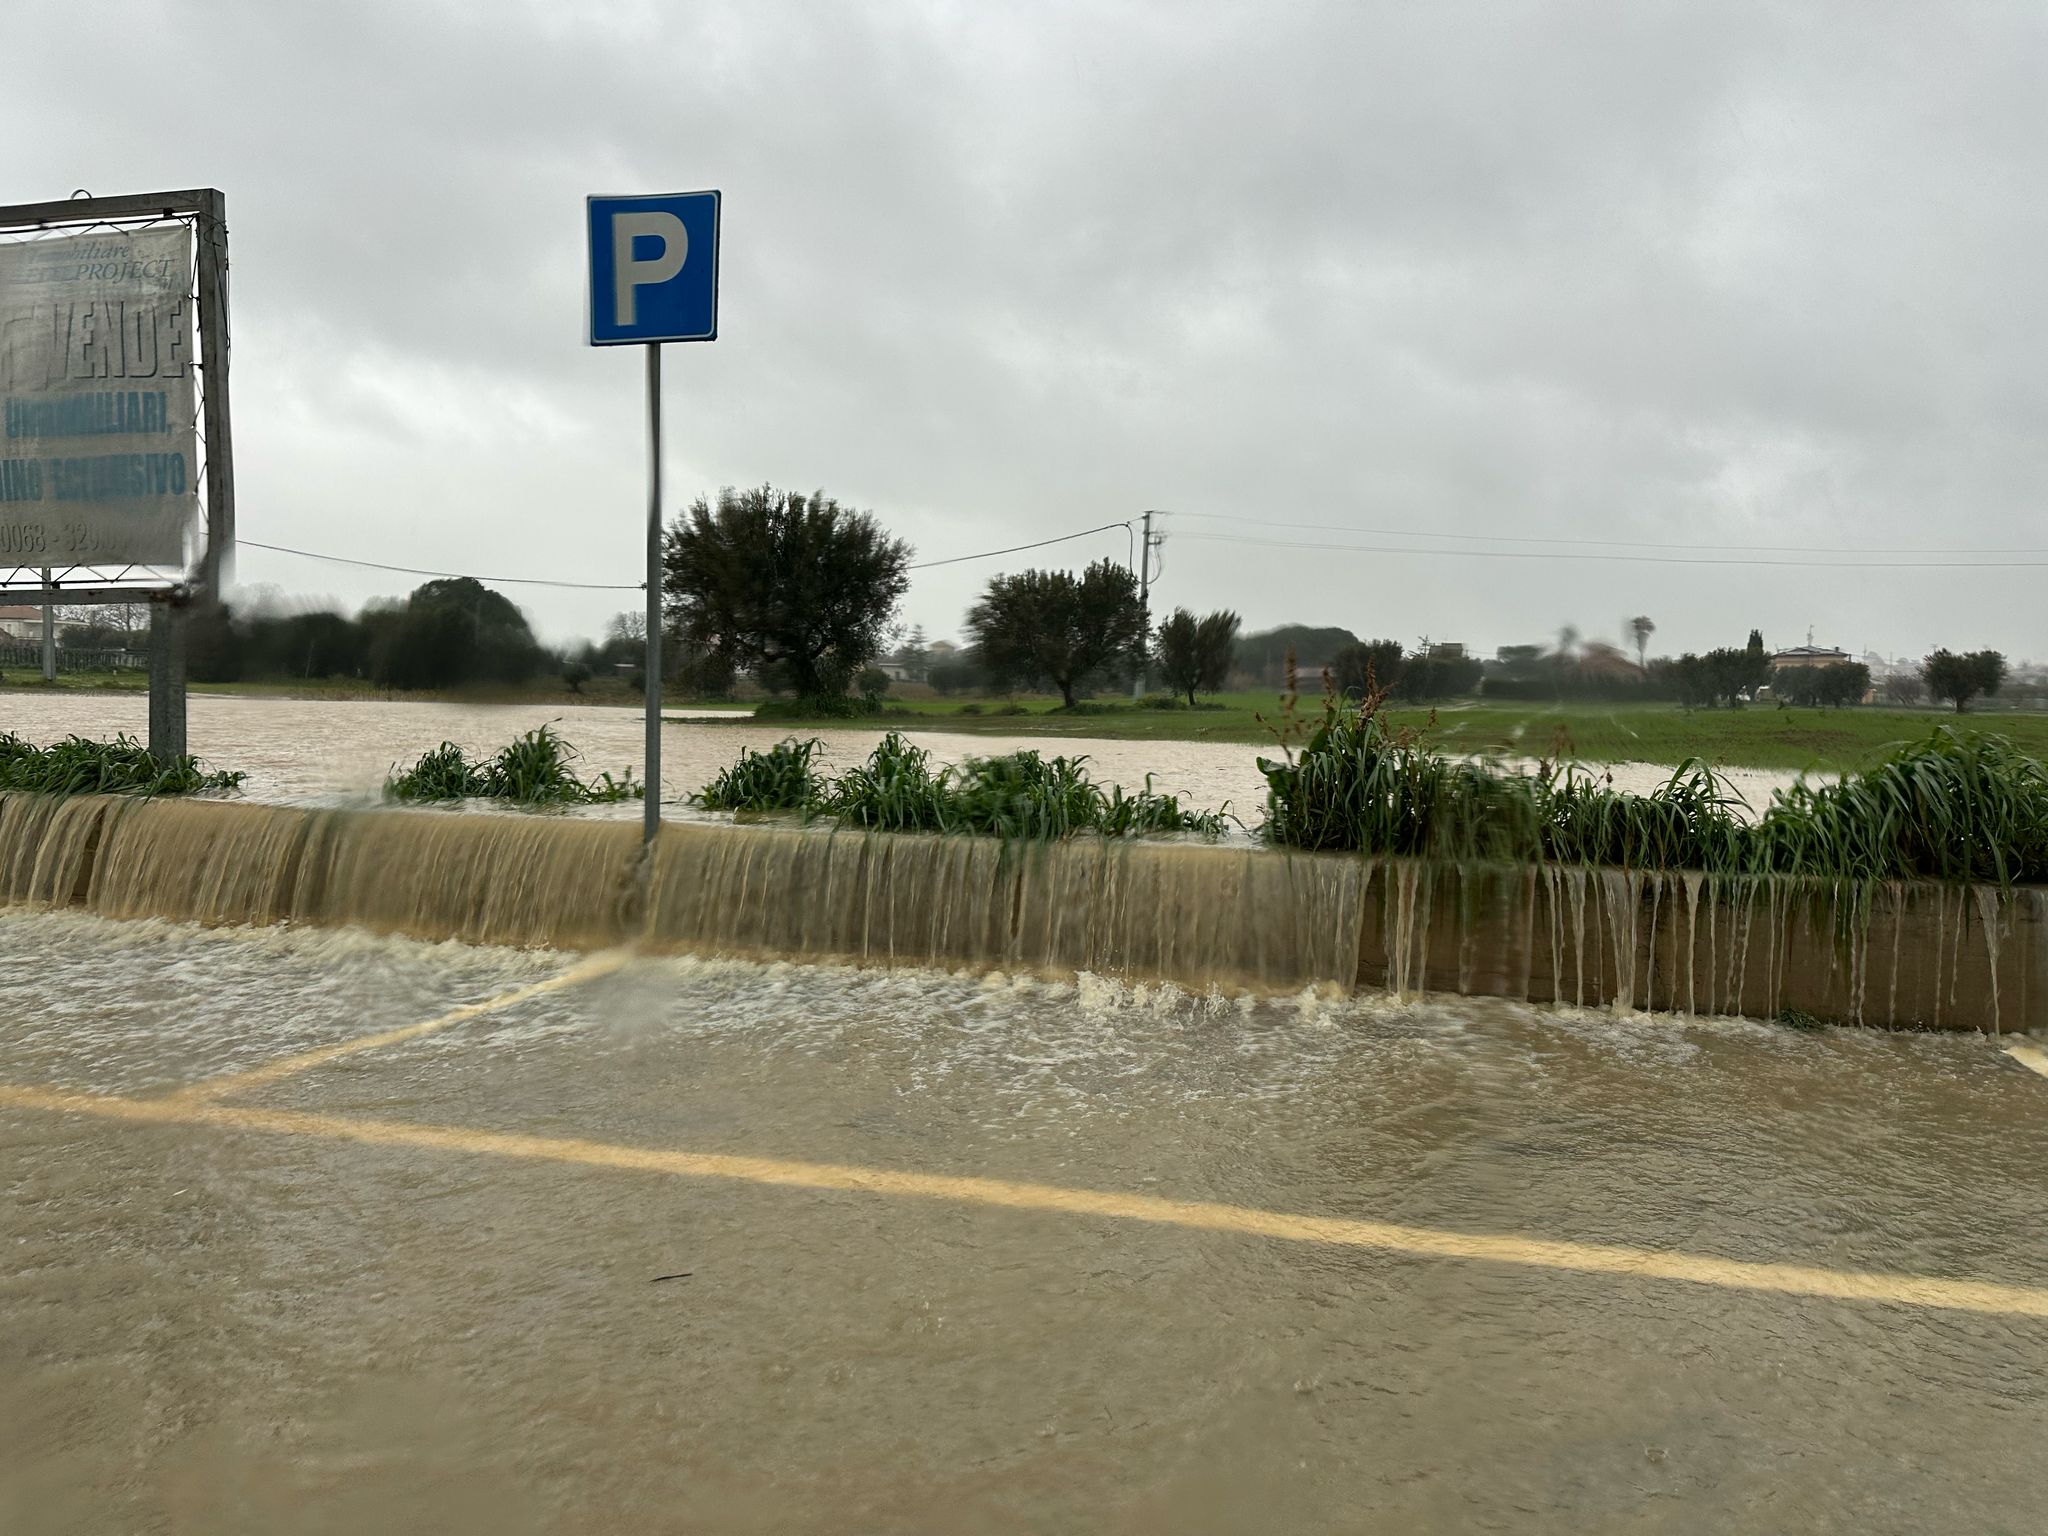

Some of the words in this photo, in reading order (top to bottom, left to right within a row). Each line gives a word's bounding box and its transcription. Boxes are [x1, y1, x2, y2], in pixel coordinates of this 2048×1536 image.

[77, 259, 177, 284] PROJECT
[612, 213, 688, 326] P
[50, 300, 184, 379] VENDE
[0, 458, 43, 501] INO
